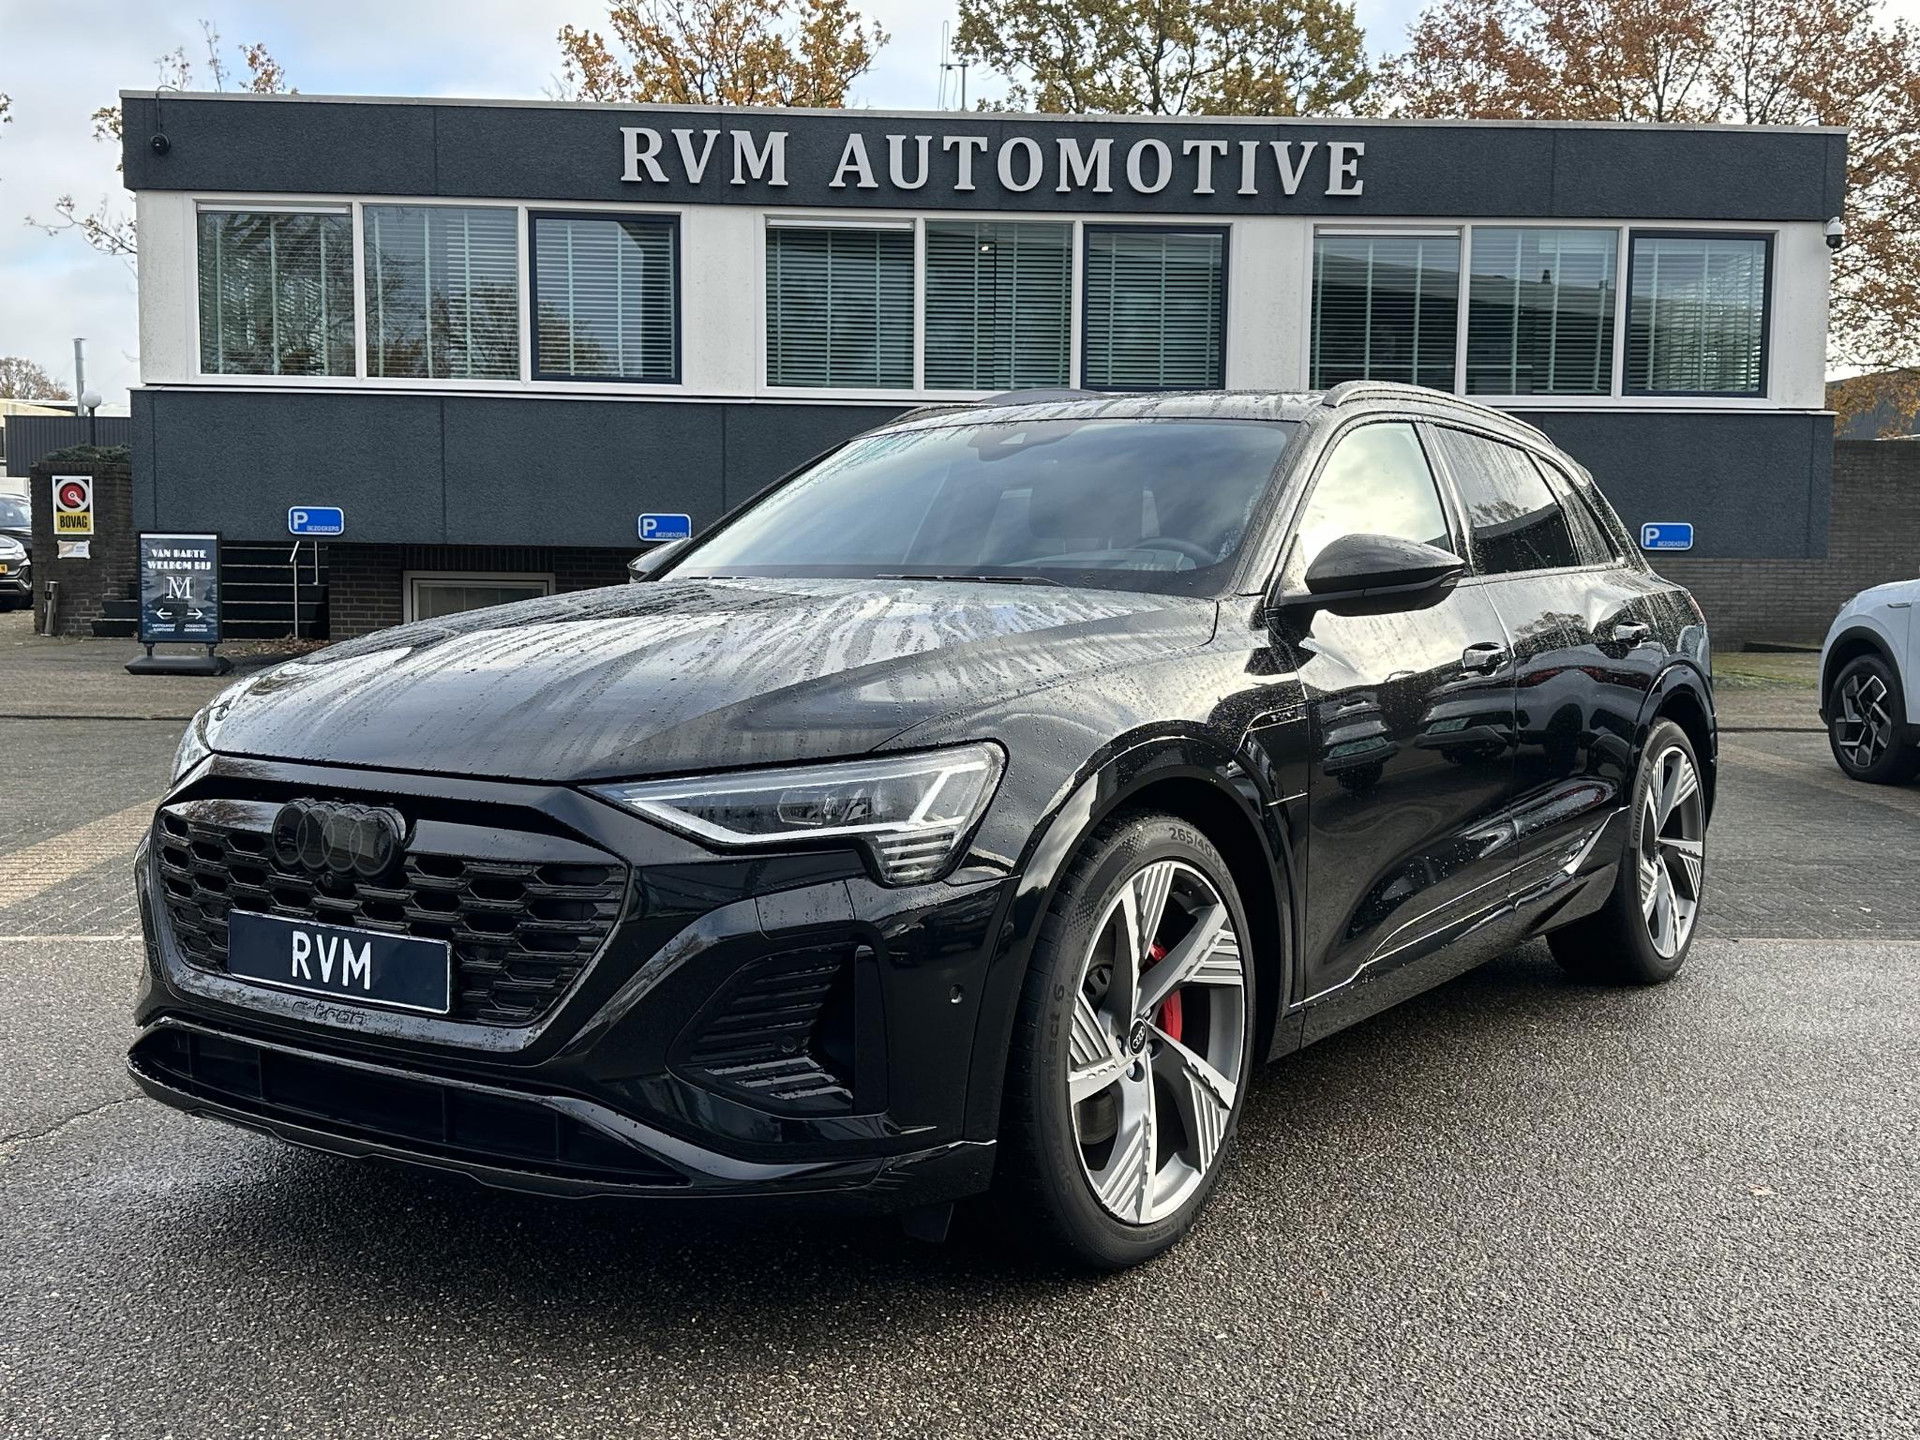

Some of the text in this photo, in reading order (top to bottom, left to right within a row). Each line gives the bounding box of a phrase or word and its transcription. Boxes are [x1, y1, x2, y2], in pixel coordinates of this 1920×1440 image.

[620, 127, 1365, 196] RVM AUTOMOTIVE
[60, 515, 87, 529] BOVAG
[293, 511, 308, 530] P
[642, 518, 657, 536] P
[1645, 527, 1660, 546] P
[151, 549, 171, 558] VAN
[147, 561, 212, 571] WELKOM BIJ
[1168, 826, 1213, 857] 265/40
[291, 930, 372, 991] RVM
